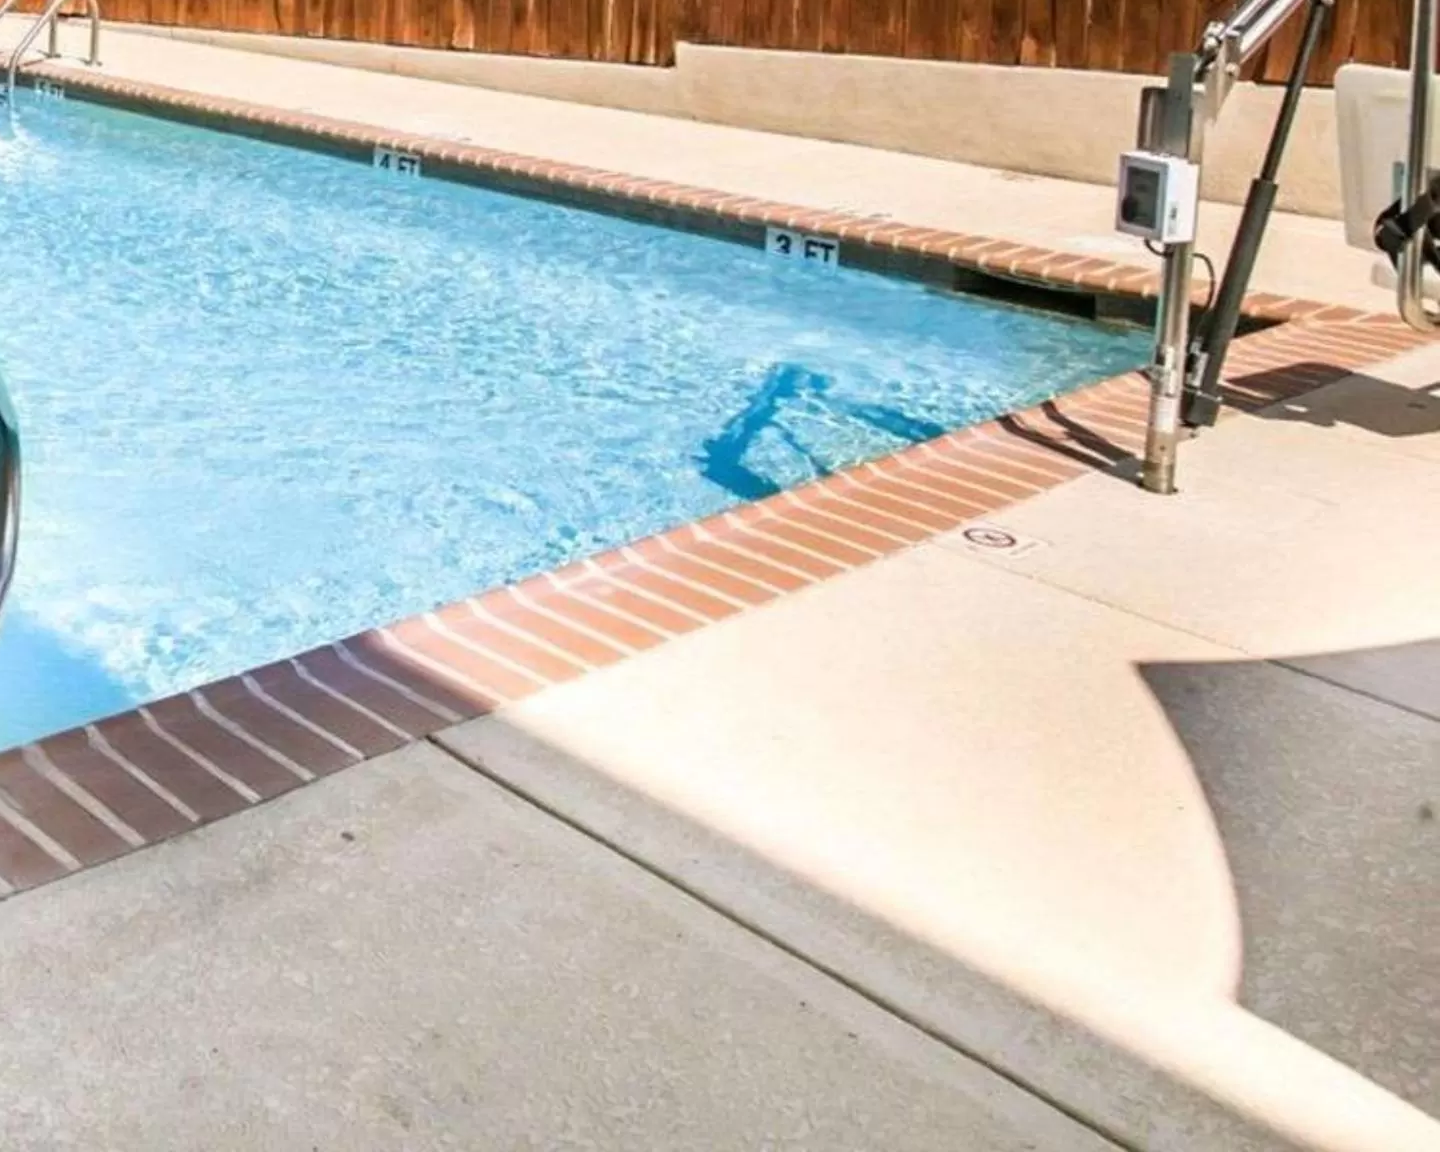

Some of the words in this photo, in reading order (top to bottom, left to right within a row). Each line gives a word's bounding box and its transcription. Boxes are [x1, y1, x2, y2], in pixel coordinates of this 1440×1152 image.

[379, 153, 389, 169] 4
[398, 157, 416, 175] FT
[804, 239, 835, 262] FT
